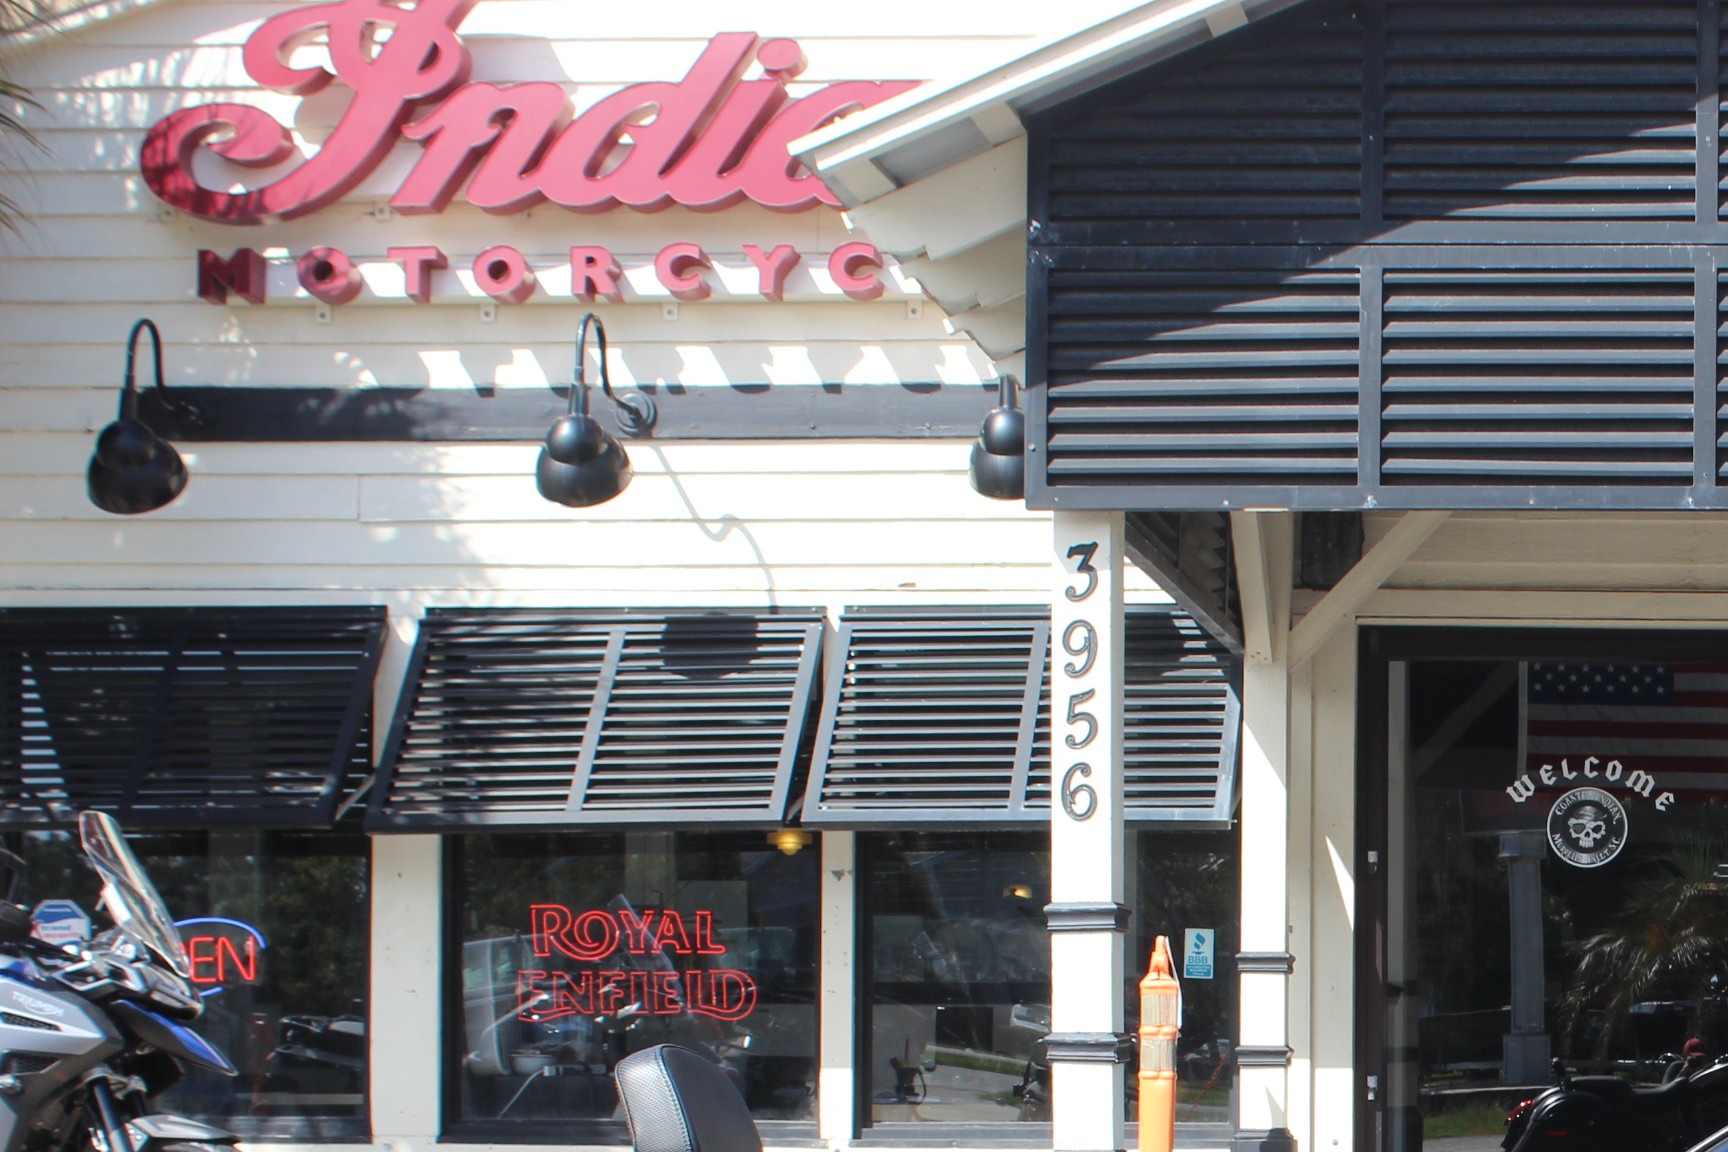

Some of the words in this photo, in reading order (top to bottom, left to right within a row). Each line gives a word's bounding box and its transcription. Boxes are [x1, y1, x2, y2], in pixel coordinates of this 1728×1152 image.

[140, 0, 936, 226] India
[197, 242, 884, 304] MOTORCYC
[1061, 541, 1099, 822] 3956
[180, 936, 257, 983] EN
[530, 904, 727, 960] ROYAL
[1188, 955, 1208, 964] BBB
[517, 969, 758, 1022] ENFIELD
